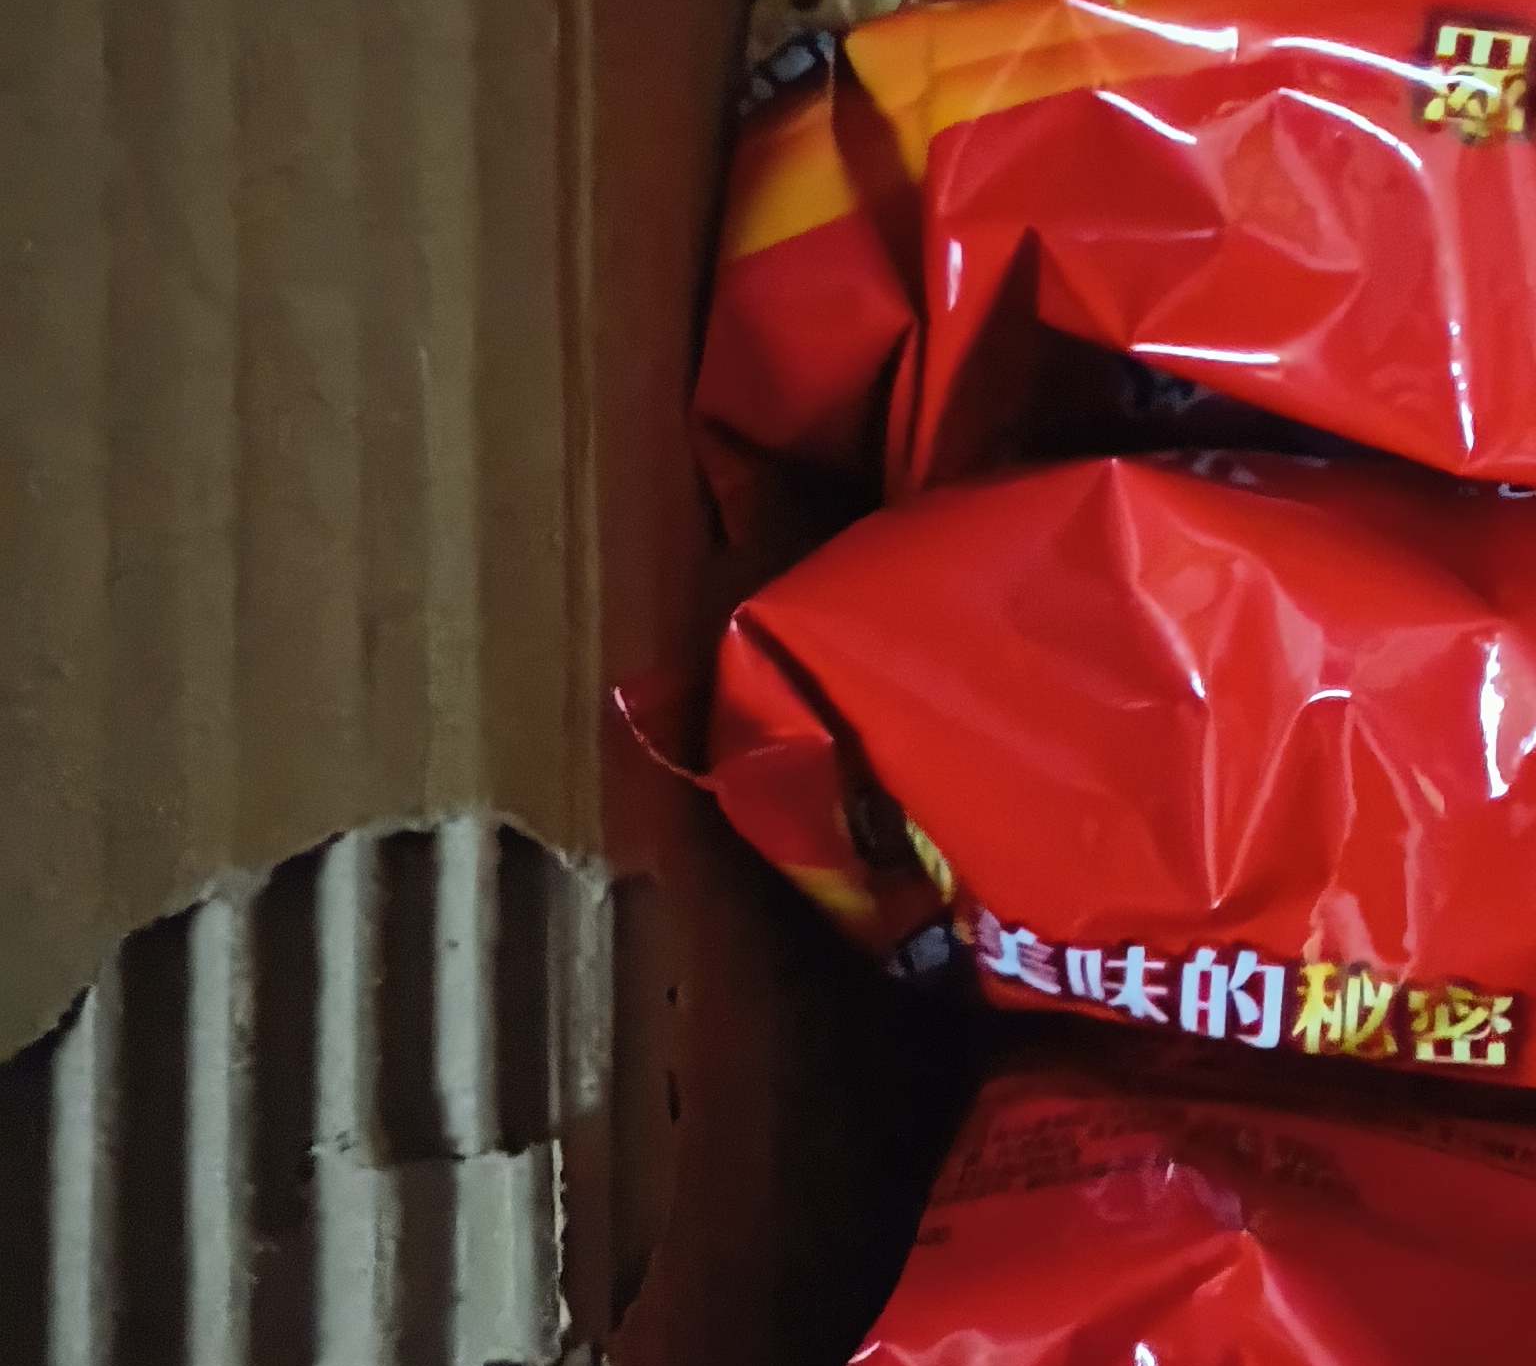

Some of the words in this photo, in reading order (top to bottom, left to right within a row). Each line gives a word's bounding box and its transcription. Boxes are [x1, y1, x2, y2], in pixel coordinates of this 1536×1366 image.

[977, 905, 1515, 1067] 美味的秘密
